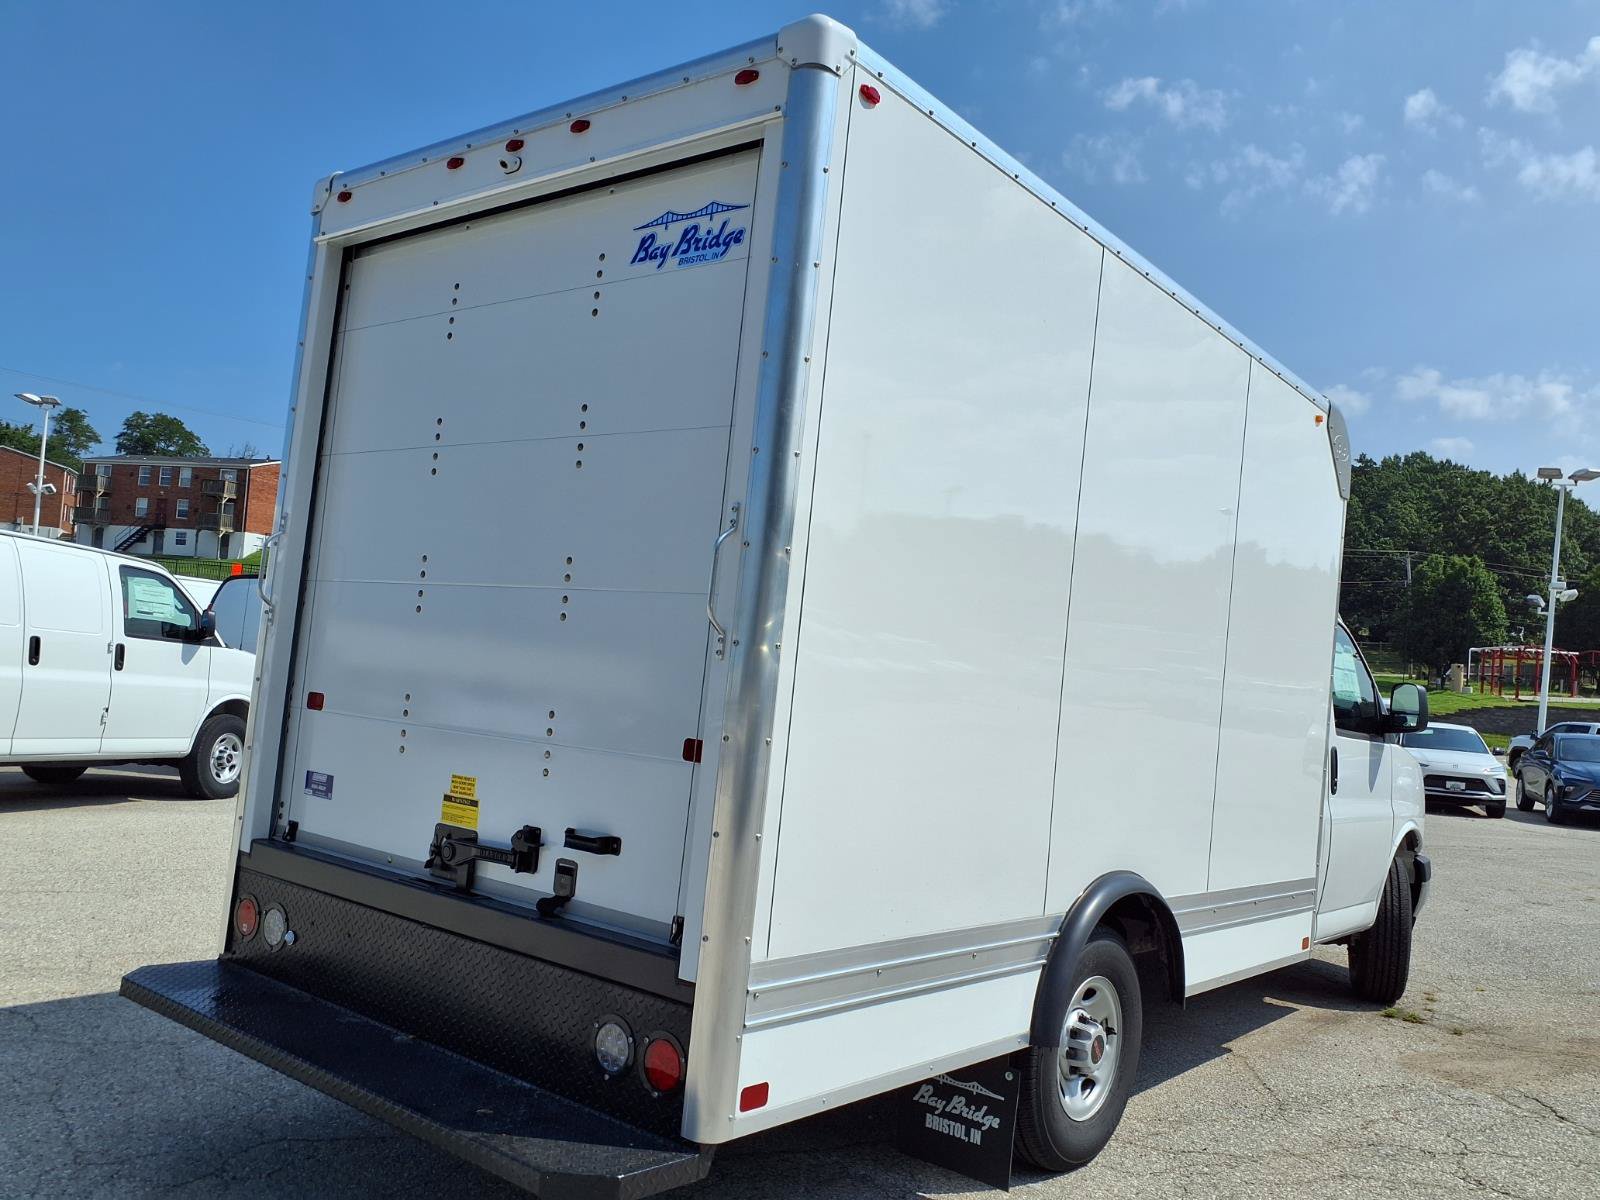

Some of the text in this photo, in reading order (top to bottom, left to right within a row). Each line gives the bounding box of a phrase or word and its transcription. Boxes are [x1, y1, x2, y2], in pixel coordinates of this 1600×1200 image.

[631, 219, 745, 269] Bay Bridge
[711, 251, 720, 261] IN
[913, 1084, 1000, 1131] Bay Bridge
[925, 1113, 982, 1145] BRISTOL, IN
